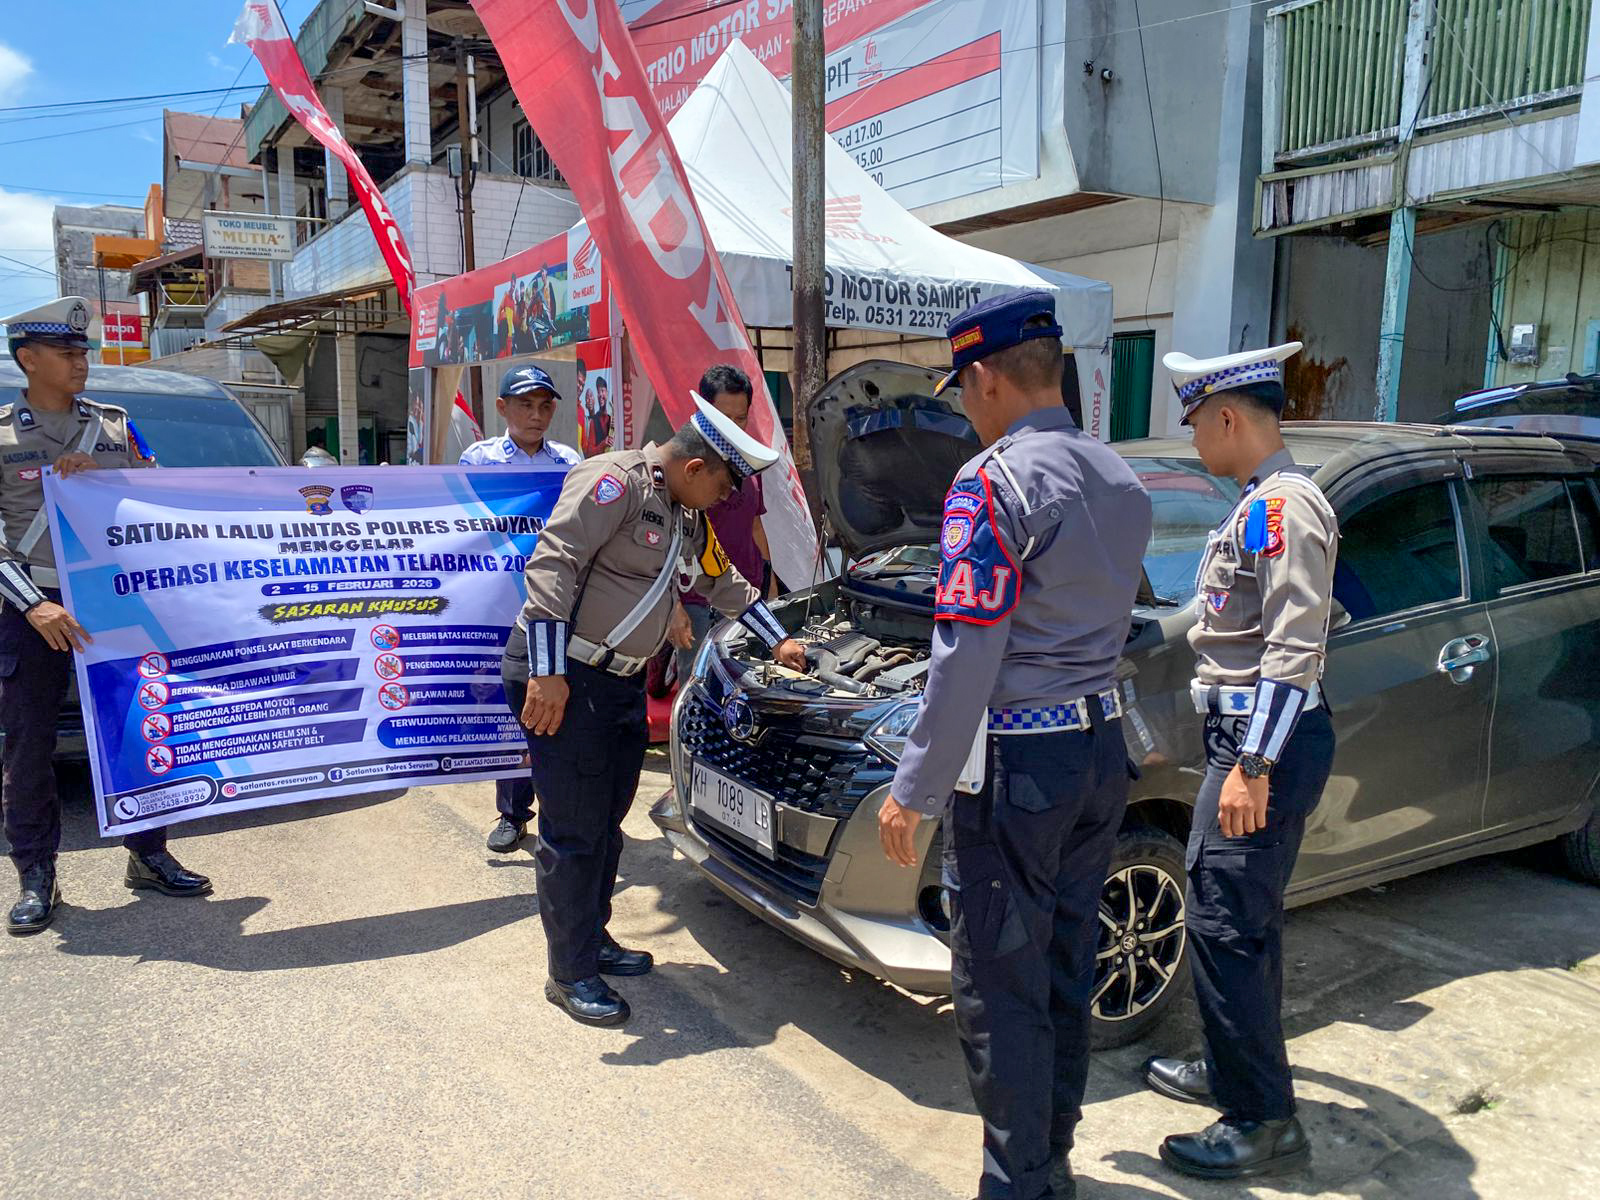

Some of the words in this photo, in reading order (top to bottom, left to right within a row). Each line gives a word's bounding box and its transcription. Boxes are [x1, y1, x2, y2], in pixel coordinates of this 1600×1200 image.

[647, 45, 686, 91] TRIO
[691, 0, 761, 66] MOTOR
[827, 57, 852, 92] PIT
[854, 119, 883, 145] 17.00
[855, 146, 883, 168] 15.00
[217, 220, 242, 230] TOKO
[243, 221, 278, 231] MEUBEL
[572, 267, 595, 280] HONDA
[582, 284, 595, 297] HEART
[841, 273, 912, 306] MOTOR
[916, 282, 981, 310] SAMPIT
[824, 300, 860, 324] Telp.
[865, 305, 903, 326] 0531
[909, 309, 950, 329] 22373
[623, 382, 634, 450] HOND
[106, 522, 209, 547] SATUAN
[214, 523, 274, 540] LALU
[280, 522, 361, 539] LINTAS
[366, 520, 450, 537] POLRES
[453, 516, 544, 534] SERUYAN
[279, 537, 415, 554] MENGGELAR
[113, 562, 217, 596] OPERASI
[224, 555, 390, 581] KESELAMATAN
[394, 553, 498, 573] TELABANG
[271, 585, 280, 594] 2
[303, 583, 319, 592] 15
[327, 580, 394, 591] FEBRUARI
[402, 579, 433, 588] 2026
[936, 560, 1012, 611] AJ
[273, 602, 364, 619] SASARAN
[367, 599, 439, 613] KHUSUS
[402, 632, 437, 640] MELEBIHI
[438, 632, 461, 640] BATAS
[461, 632, 498, 640] KECEPATAN
[171, 650, 234, 667] MENGGUNAKAN
[235, 644, 267, 657] PONSEL
[268, 641, 289, 652] SAAT
[291, 636, 347, 648] BERKENDARA
[405, 660, 455, 669] PENGENDARA
[456, 660, 479, 669] DALAM
[171, 682, 229, 696] BERKENDARA
[231, 675, 270, 689] DIBAWAH
[271, 671, 296, 683] UMUR
[410, 691, 447, 700] MELAWAN
[447, 690, 465, 698] ARUS
[172, 708, 230, 723] PENGENDARA
[231, 703, 262, 715] SEPEDA
[263, 698, 295, 709] MOTOR
[173, 715, 242, 733] BERBONCENGAN
[243, 709, 268, 721] LEBIH
[269, 707, 291, 718] DARI
[291, 706, 297, 715] 1
[298, 703, 329, 715] ORANG
[390, 717, 455, 728] TERWUJUDNYA
[175, 744, 201, 756] TIDAK
[202, 733, 270, 751] MENGGUNAKAN
[271, 729, 295, 741] HELM
[296, 728, 310, 737] SNI
[311, 726, 318, 735] &
[175, 752, 202, 765] TIDAK
[203, 743, 271, 762] MENGGUNAKAN
[272, 738, 303, 750] SAFETY
[304, 735, 325, 746] BELT
[395, 733, 447, 746] MENJELANG
[385, 764, 407, 772] Polres
[408, 761, 433, 771] Seruyan
[453, 759, 464, 767] SAT
[464, 758, 483, 766] LANTAS
[693, 766, 707, 797] KH
[717, 778, 744, 816] 1089
[754, 798, 769, 830] LB
